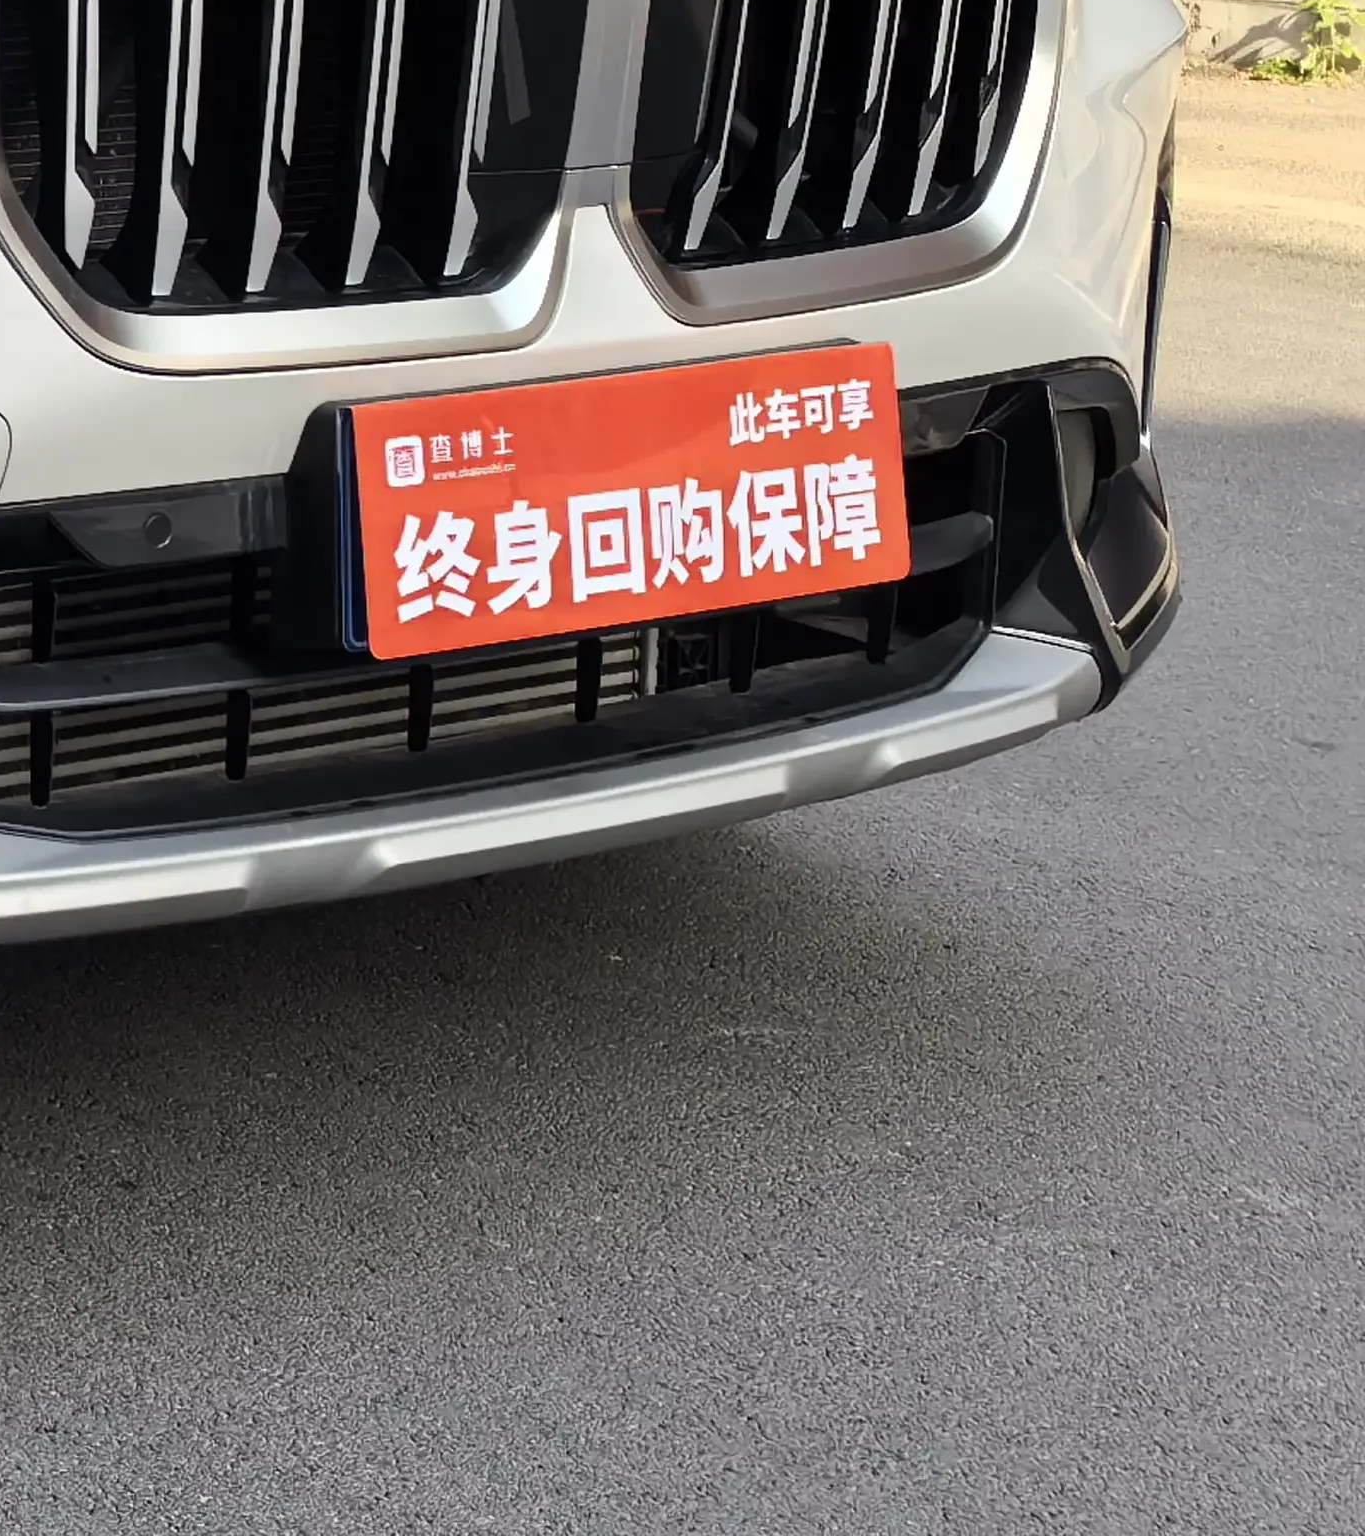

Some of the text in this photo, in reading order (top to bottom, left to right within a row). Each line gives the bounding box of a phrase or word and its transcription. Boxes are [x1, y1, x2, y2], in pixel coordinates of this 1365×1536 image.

[429, 426, 515, 464] 查博士
[728, 378, 874, 447] 此车可享
[394, 454, 882, 624] 终身回购保障
